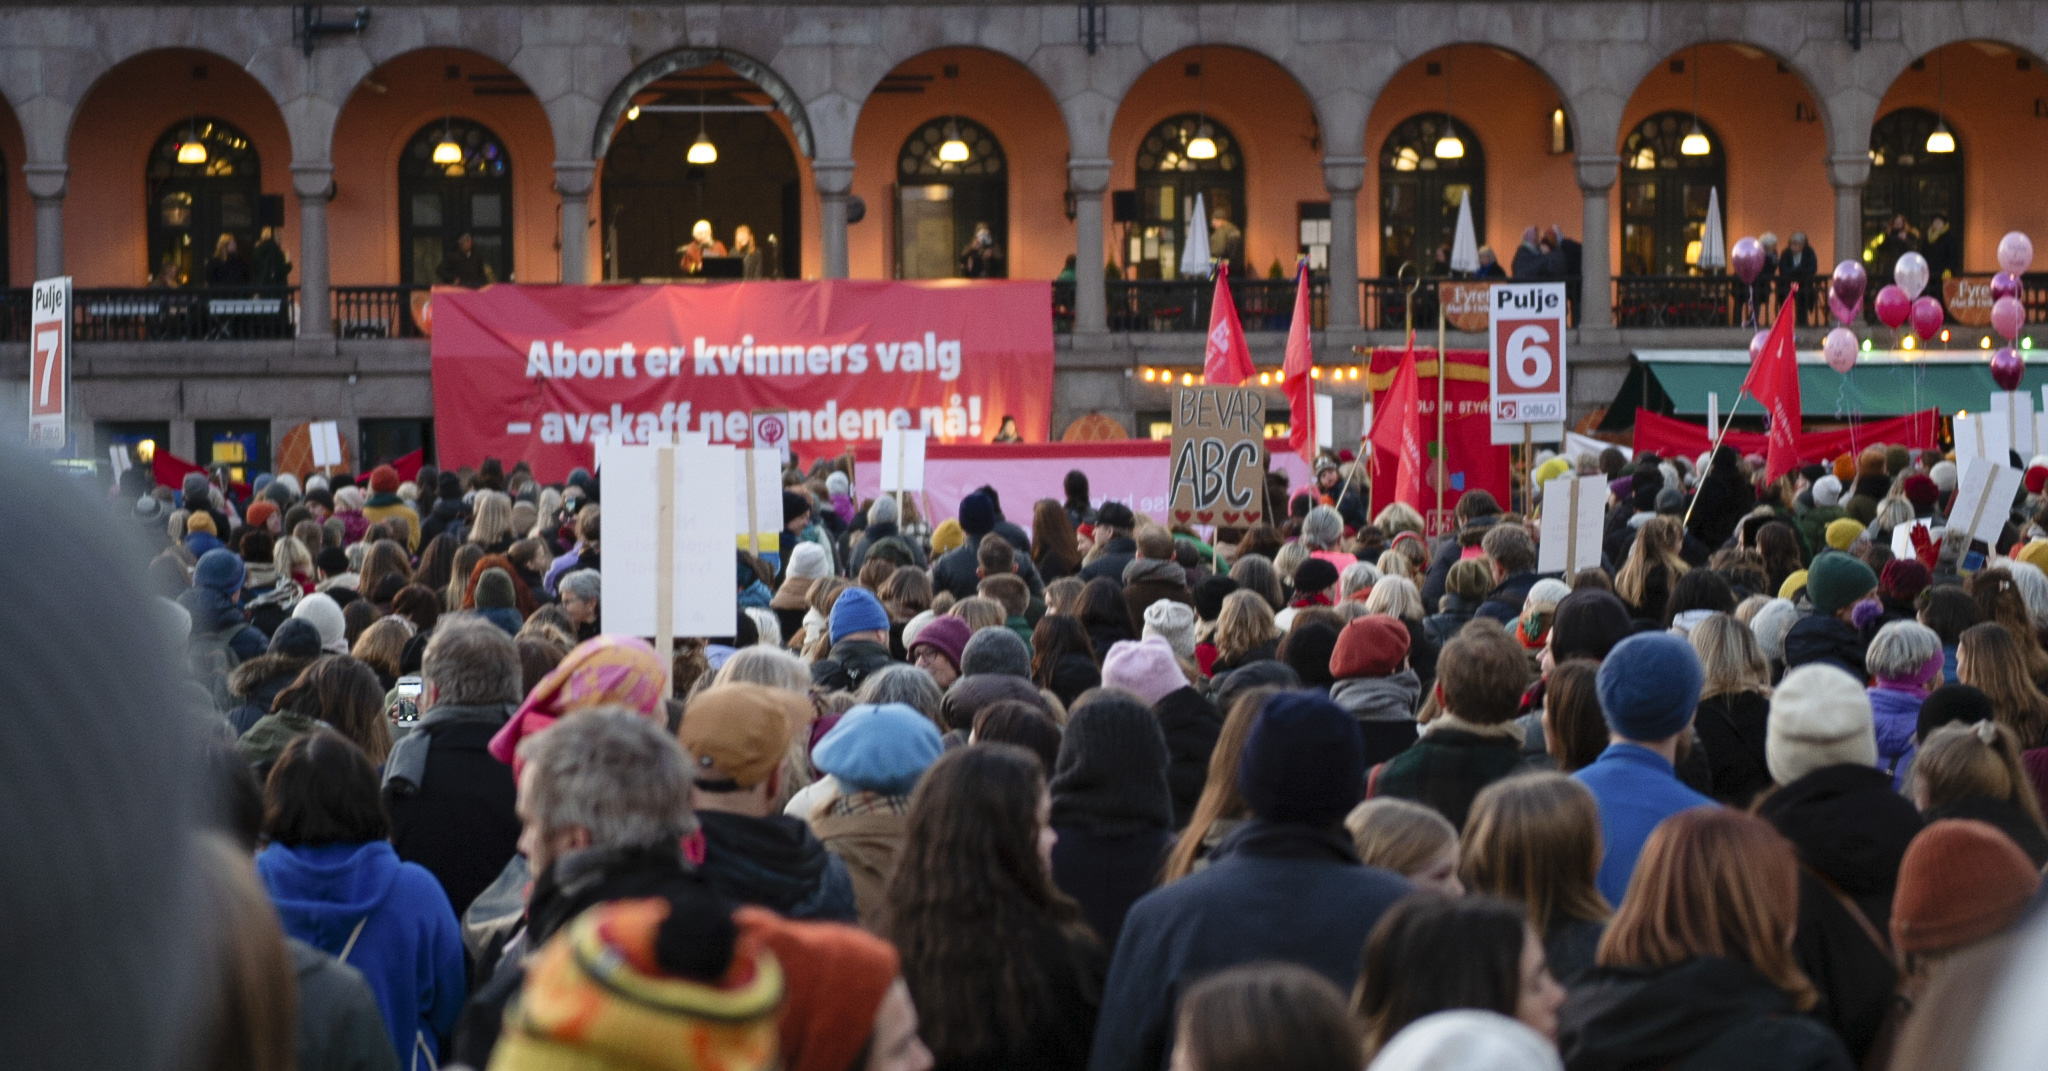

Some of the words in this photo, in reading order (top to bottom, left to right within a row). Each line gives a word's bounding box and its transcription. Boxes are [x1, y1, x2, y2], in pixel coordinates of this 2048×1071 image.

[35, 284, 62, 314] Pulje
[1497, 289, 1559, 313] Pulje
[37, 329, 59, 407] 7
[526, 340, 636, 378] Abort
[644, 346, 685, 377] er
[694, 334, 868, 376] kvinners
[875, 331, 961, 381] valg
[1506, 324, 1552, 389] 6
[540, 401, 692, 443] avskaff
[700, 400, 911, 443] nendene
[920, 393, 982, 438] nå!
[1180, 388, 1263, 434] BEVAR
[1170, 437, 1258, 510] ABC
